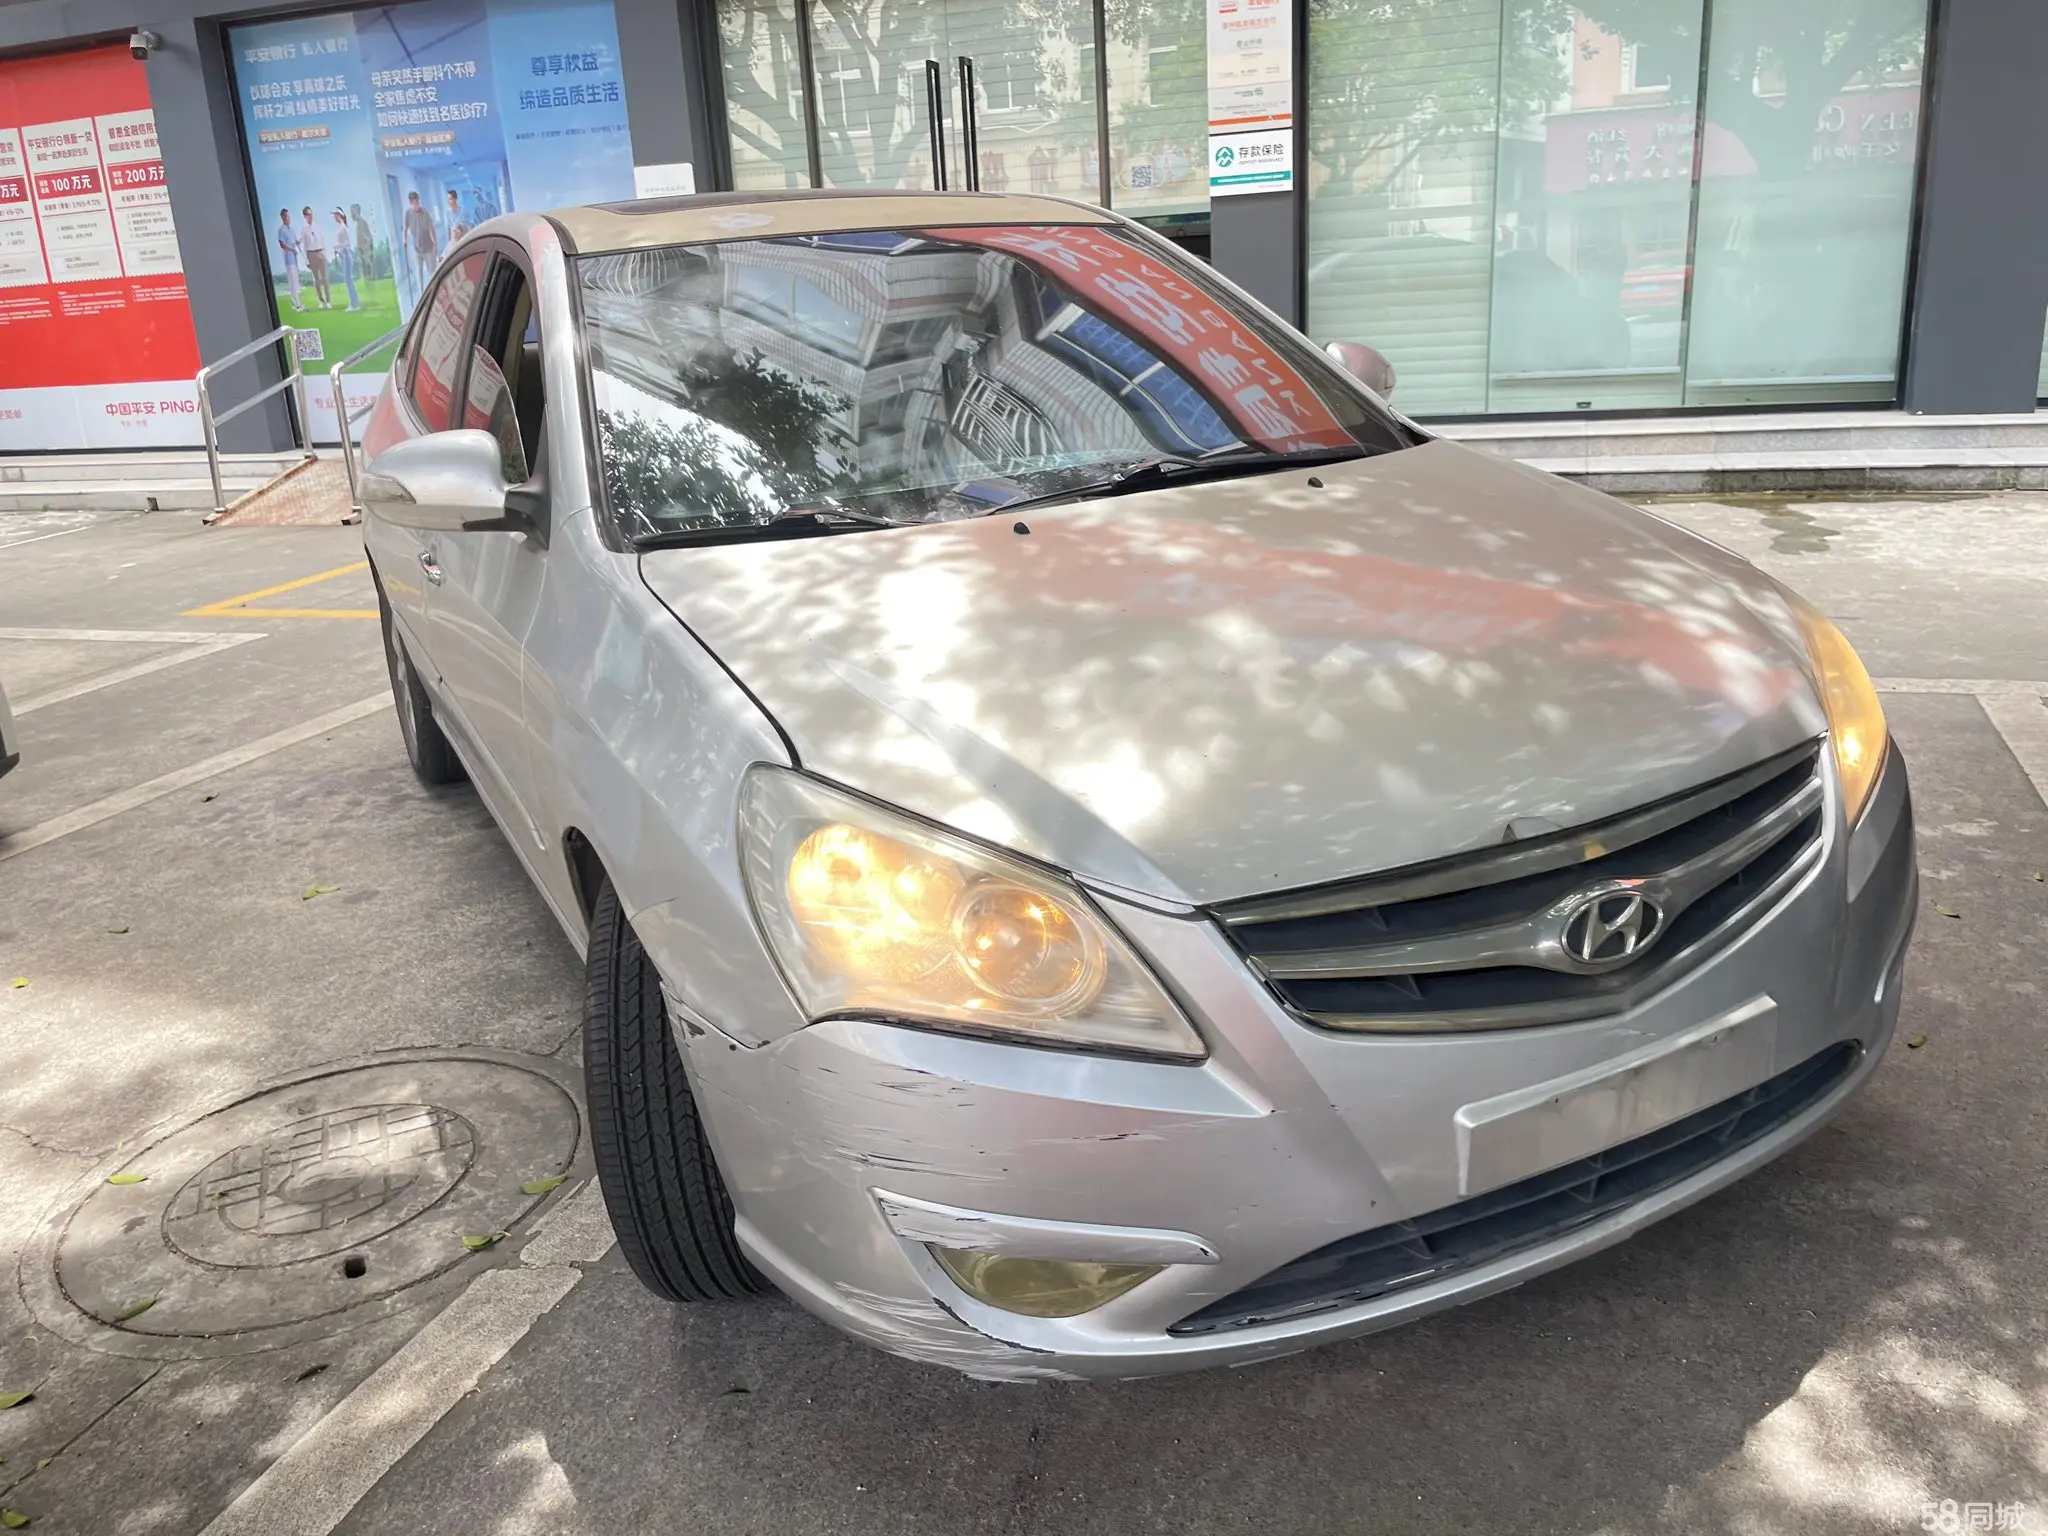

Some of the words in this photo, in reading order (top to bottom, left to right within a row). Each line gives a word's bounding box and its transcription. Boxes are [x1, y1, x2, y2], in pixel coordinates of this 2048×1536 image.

[244, 44, 296, 63] 平安银行
[301, 38, 348, 56] 私人银行
[531, 53, 599, 76] 尊享权益
[374, 86, 438, 108] 全家焦虑不安
[519, 81, 620, 110] 缔造品质生活
[1238, 144, 1284, 160] 存款保险
[51, 178, 70, 191] 100
[71, 175, 92, 190] 万元
[125, 169, 146, 183] 200
[105, 401, 157, 416] 中国平安
[160, 400, 194, 414] PING
